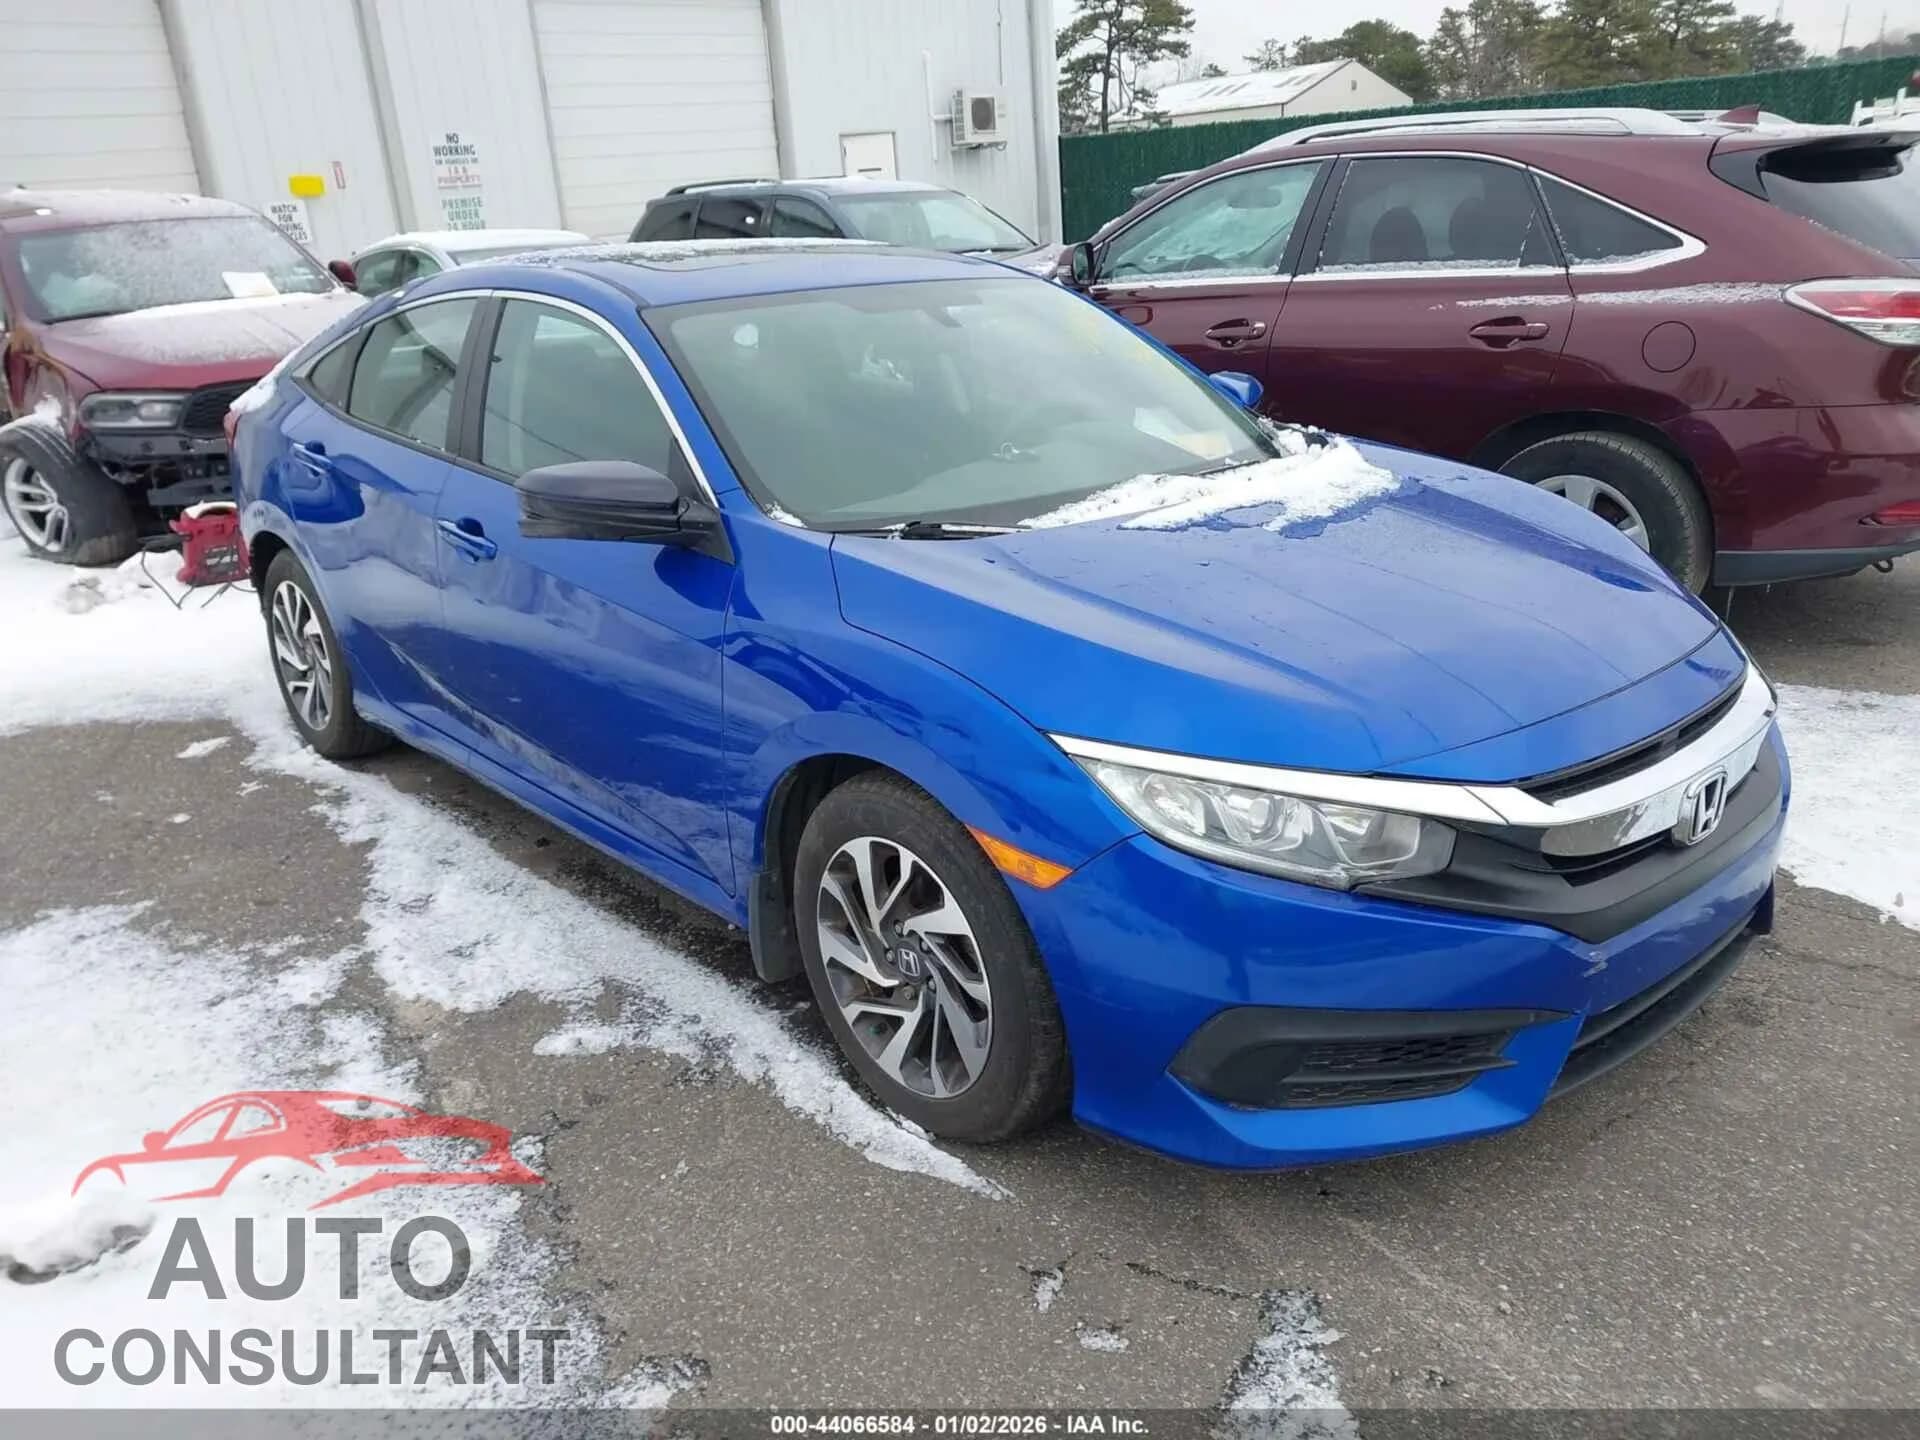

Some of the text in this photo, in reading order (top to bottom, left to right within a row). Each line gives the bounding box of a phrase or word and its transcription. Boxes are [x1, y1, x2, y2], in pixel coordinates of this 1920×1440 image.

[445, 132, 459, 144] NO
[432, 144, 476, 157] WORKING
[270, 203, 298, 214] WATCH
[441, 196, 483, 209] PREMISE
[277, 213, 293, 223] FOR
[447, 208, 480, 222] UNDER
